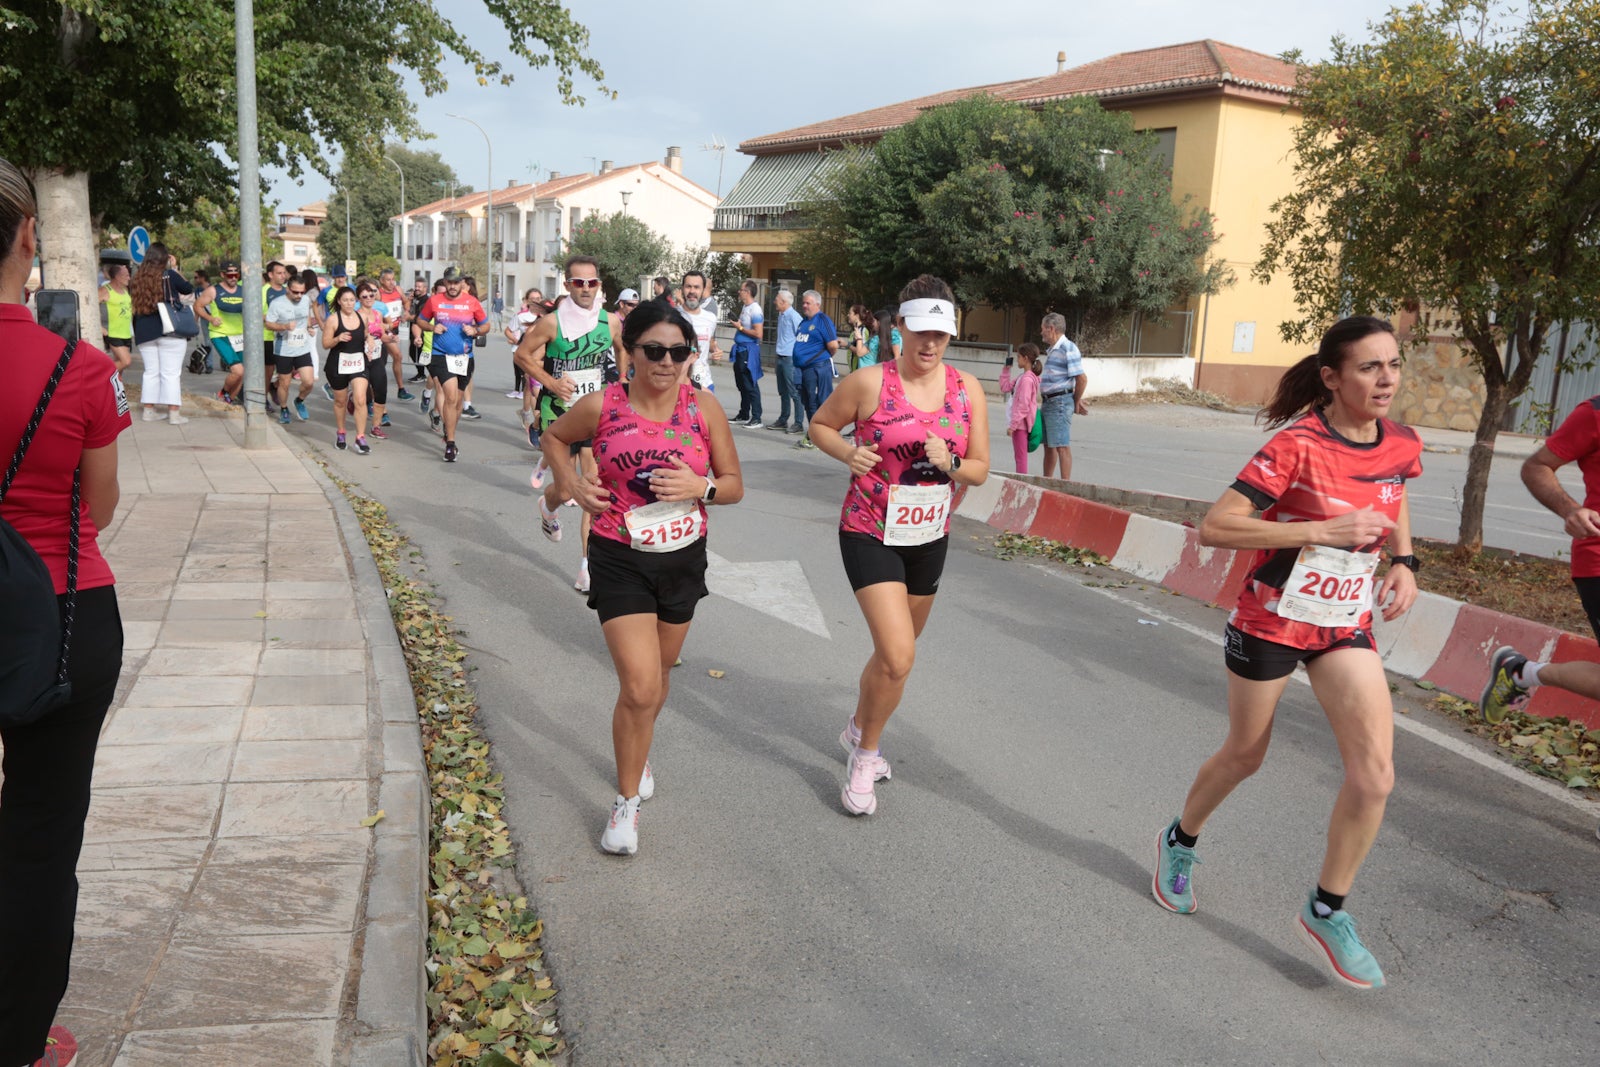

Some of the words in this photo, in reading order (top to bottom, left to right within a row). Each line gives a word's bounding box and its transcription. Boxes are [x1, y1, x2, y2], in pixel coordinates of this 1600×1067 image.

[342, 359, 362, 367] 2015
[896, 503, 944, 526] 2041
[641, 516, 695, 546] 2152
[1298, 571, 1364, 601] 2002
